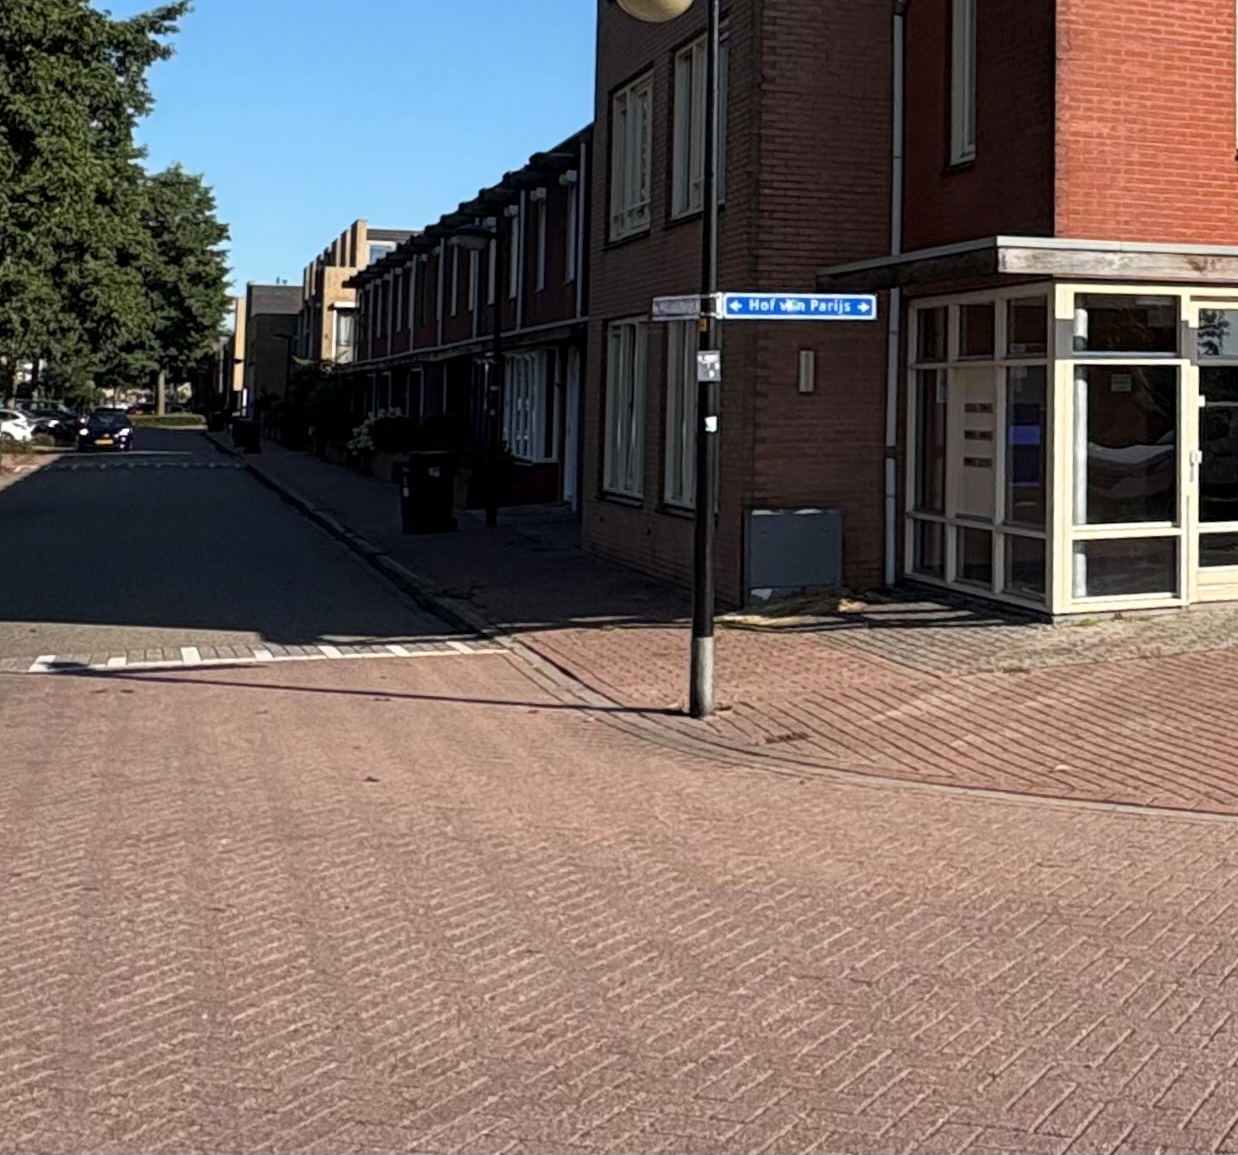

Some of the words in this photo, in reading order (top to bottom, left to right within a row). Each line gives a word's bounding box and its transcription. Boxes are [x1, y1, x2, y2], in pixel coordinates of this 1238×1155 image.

[749, 299, 776, 312] Hof
[779, 300, 806, 312] vn
[810, 299, 852, 315] Parijs
